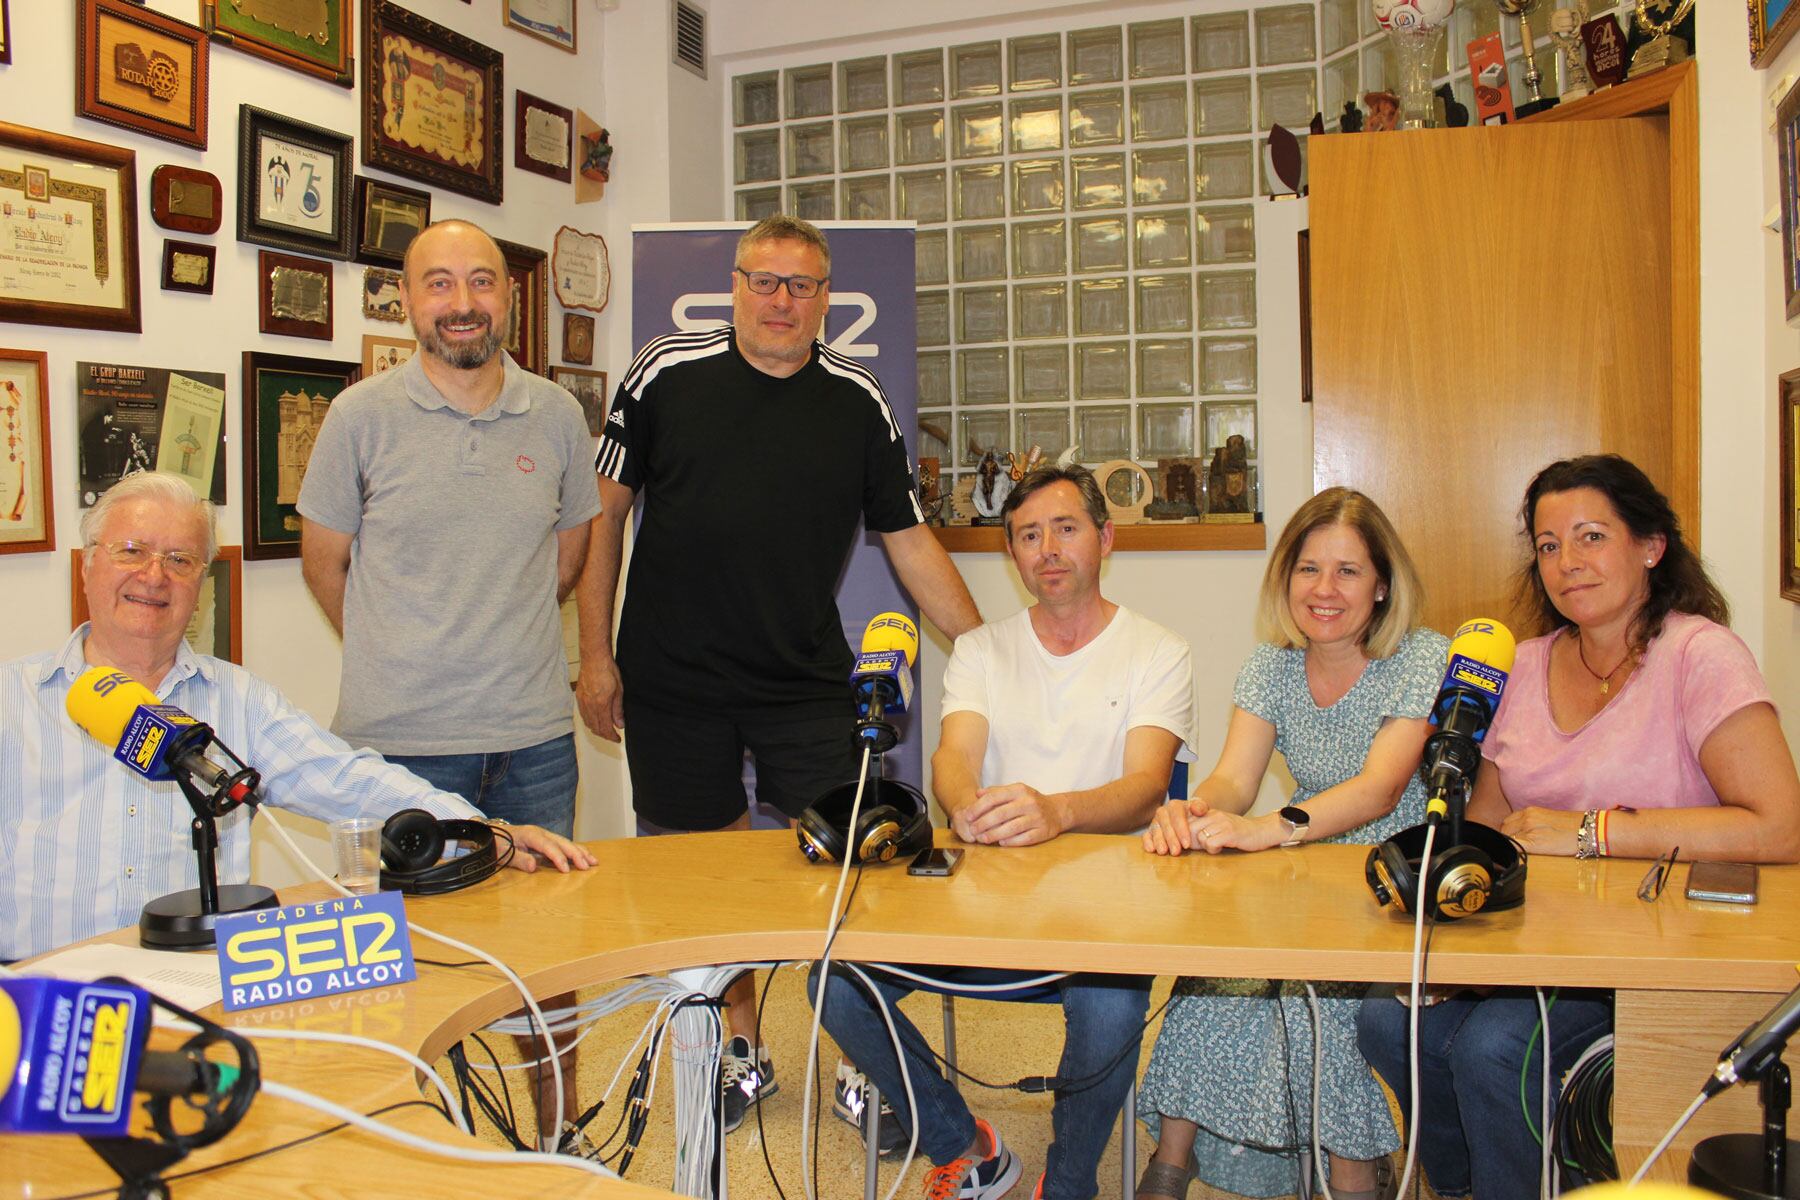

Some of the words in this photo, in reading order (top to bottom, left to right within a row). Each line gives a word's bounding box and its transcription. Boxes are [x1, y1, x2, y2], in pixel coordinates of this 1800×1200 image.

[90, 366, 98, 377] EL
[870, 618, 916, 642] SER
[1456, 670, 1497, 693] SER
[1461, 658, 1480, 670] RADIO
[1480, 666, 1502, 677] ALCOY
[120, 735, 135, 756] RADIO
[130, 714, 144, 737] ALCOY
[130, 721, 153, 761] CADENA
[136, 726, 165, 769] SER
[256, 899, 364, 924] CADENA
[226, 912, 402, 986] SER
[232, 977, 313, 1006] RADIO
[326, 962, 404, 991] ALCOY
[82, 1002, 130, 1112] SER
